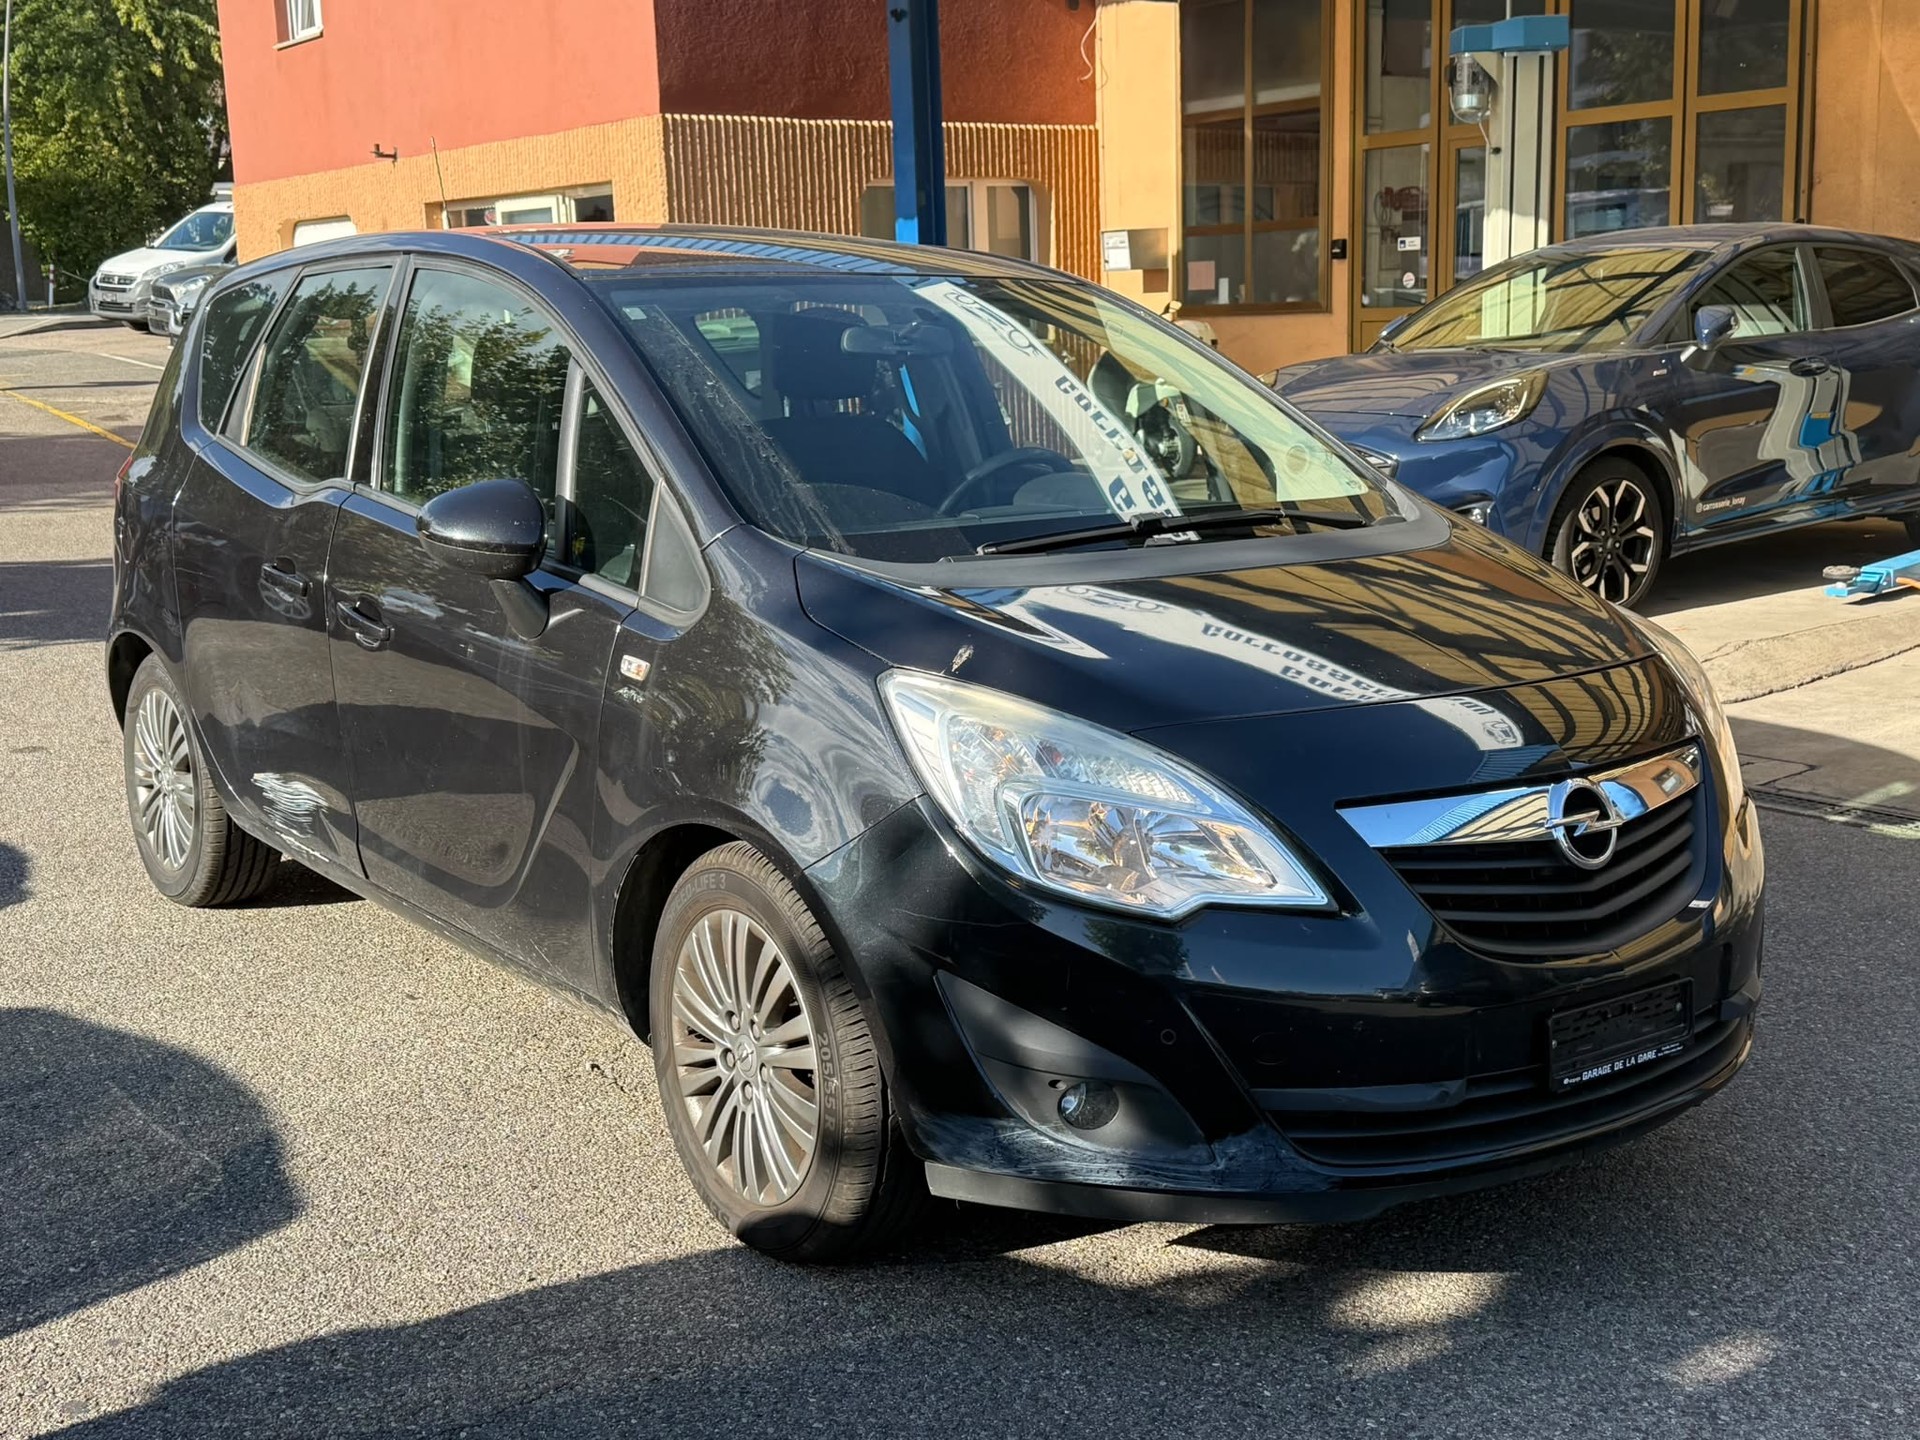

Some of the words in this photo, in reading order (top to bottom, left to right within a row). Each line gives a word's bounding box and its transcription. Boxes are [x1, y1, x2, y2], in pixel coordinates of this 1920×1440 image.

[816, 1031, 837, 1109] 205/55
[1582, 1064, 1612, 1080] GARAGE
[1614, 1060, 1624, 1070] DE
[1626, 1057, 1636, 1066] LA
[1638, 1050, 1656, 1063] GARE
